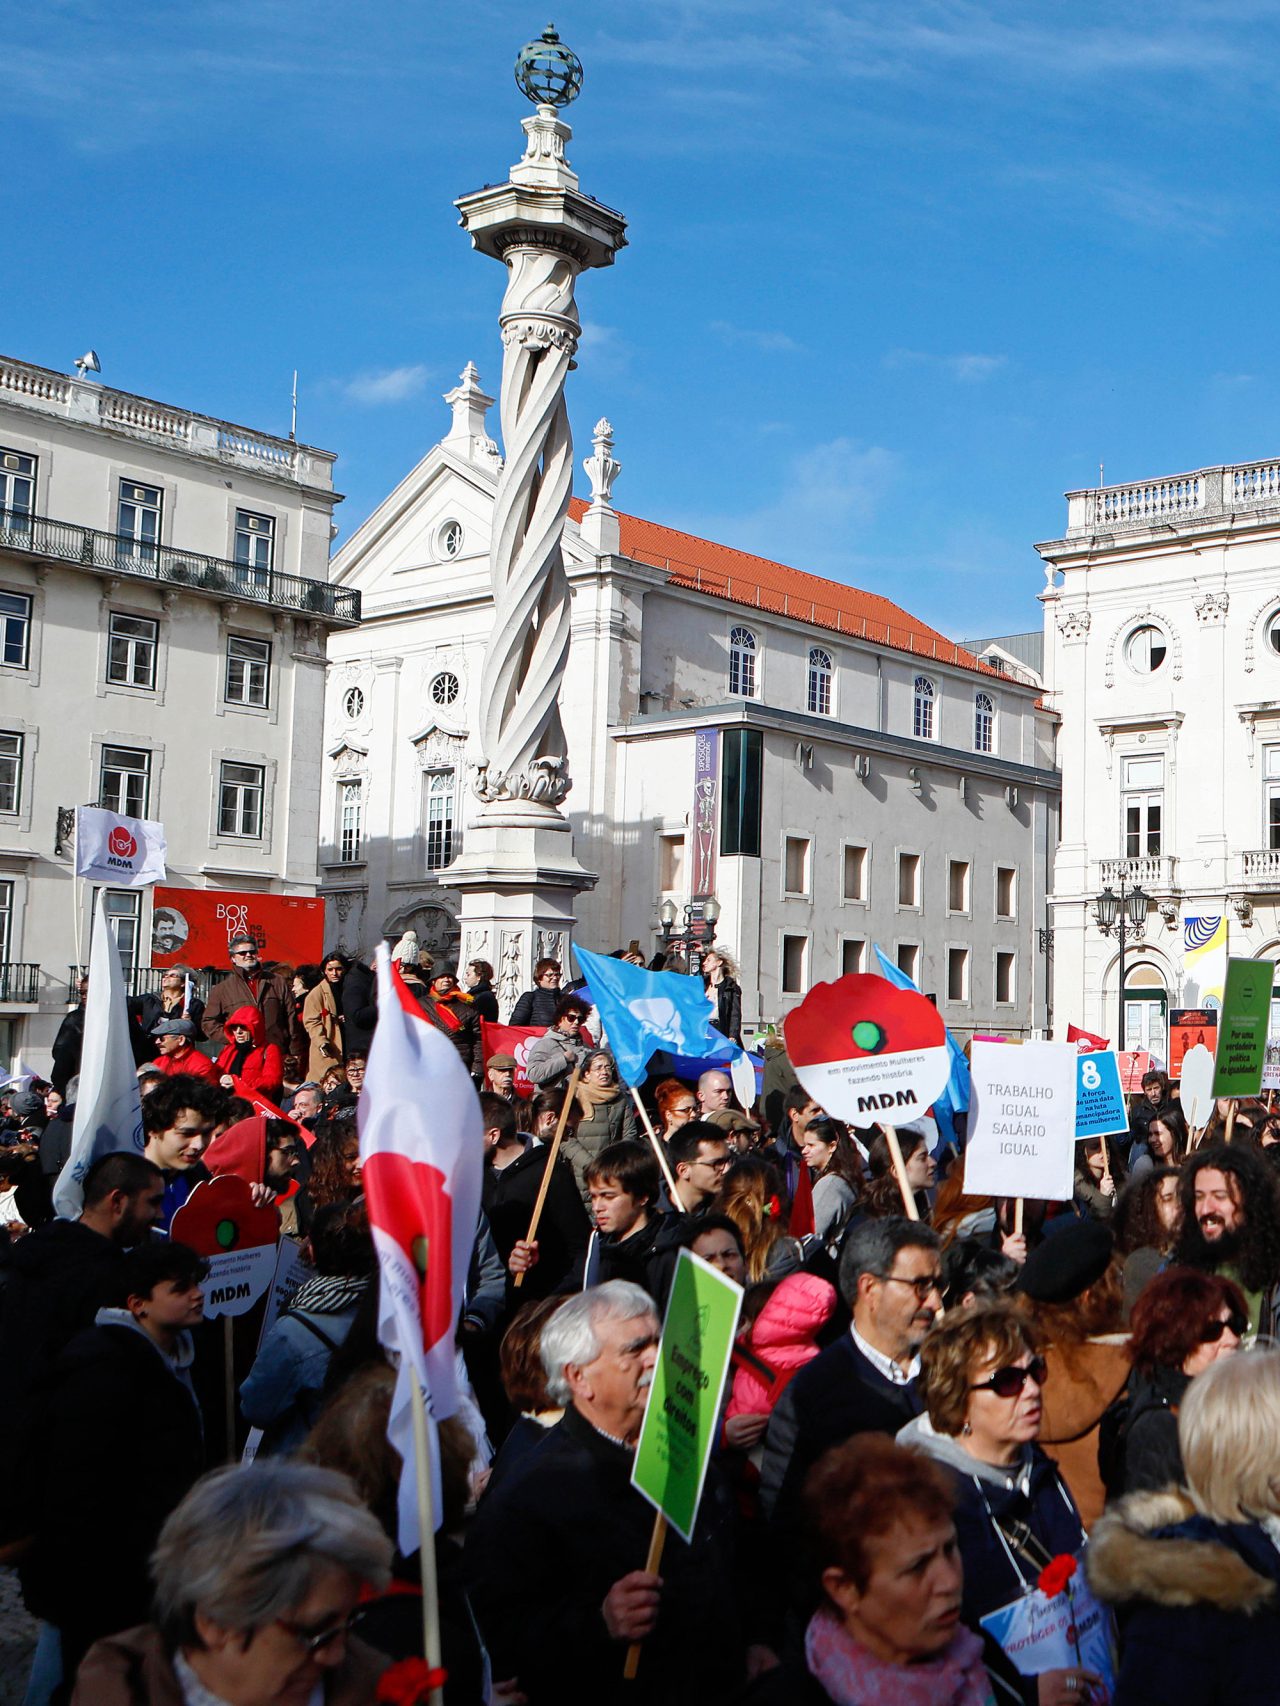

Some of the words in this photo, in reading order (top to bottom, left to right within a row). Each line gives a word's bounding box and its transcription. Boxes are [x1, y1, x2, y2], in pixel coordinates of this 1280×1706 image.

[107, 857, 133, 869] MDM
[216, 903, 248, 920] BOR
[842, 1060, 889, 1074] movimento
[889, 1054, 926, 1067] Mulheres
[848, 1074, 881, 1085] fazendo
[881, 1069, 913, 1081] história
[1082, 1060, 1101, 1090] 8
[987, 1083, 1054, 1100] TRABALHO
[857, 1089, 918, 1112] MDM
[1001, 1104, 1039, 1118] IGUAL
[992, 1121, 1046, 1138] SALÁRIO
[1000, 1142, 1039, 1156] IGUAL
[210, 1282, 251, 1305] MDM
[671, 1343, 710, 1391] Emprego
